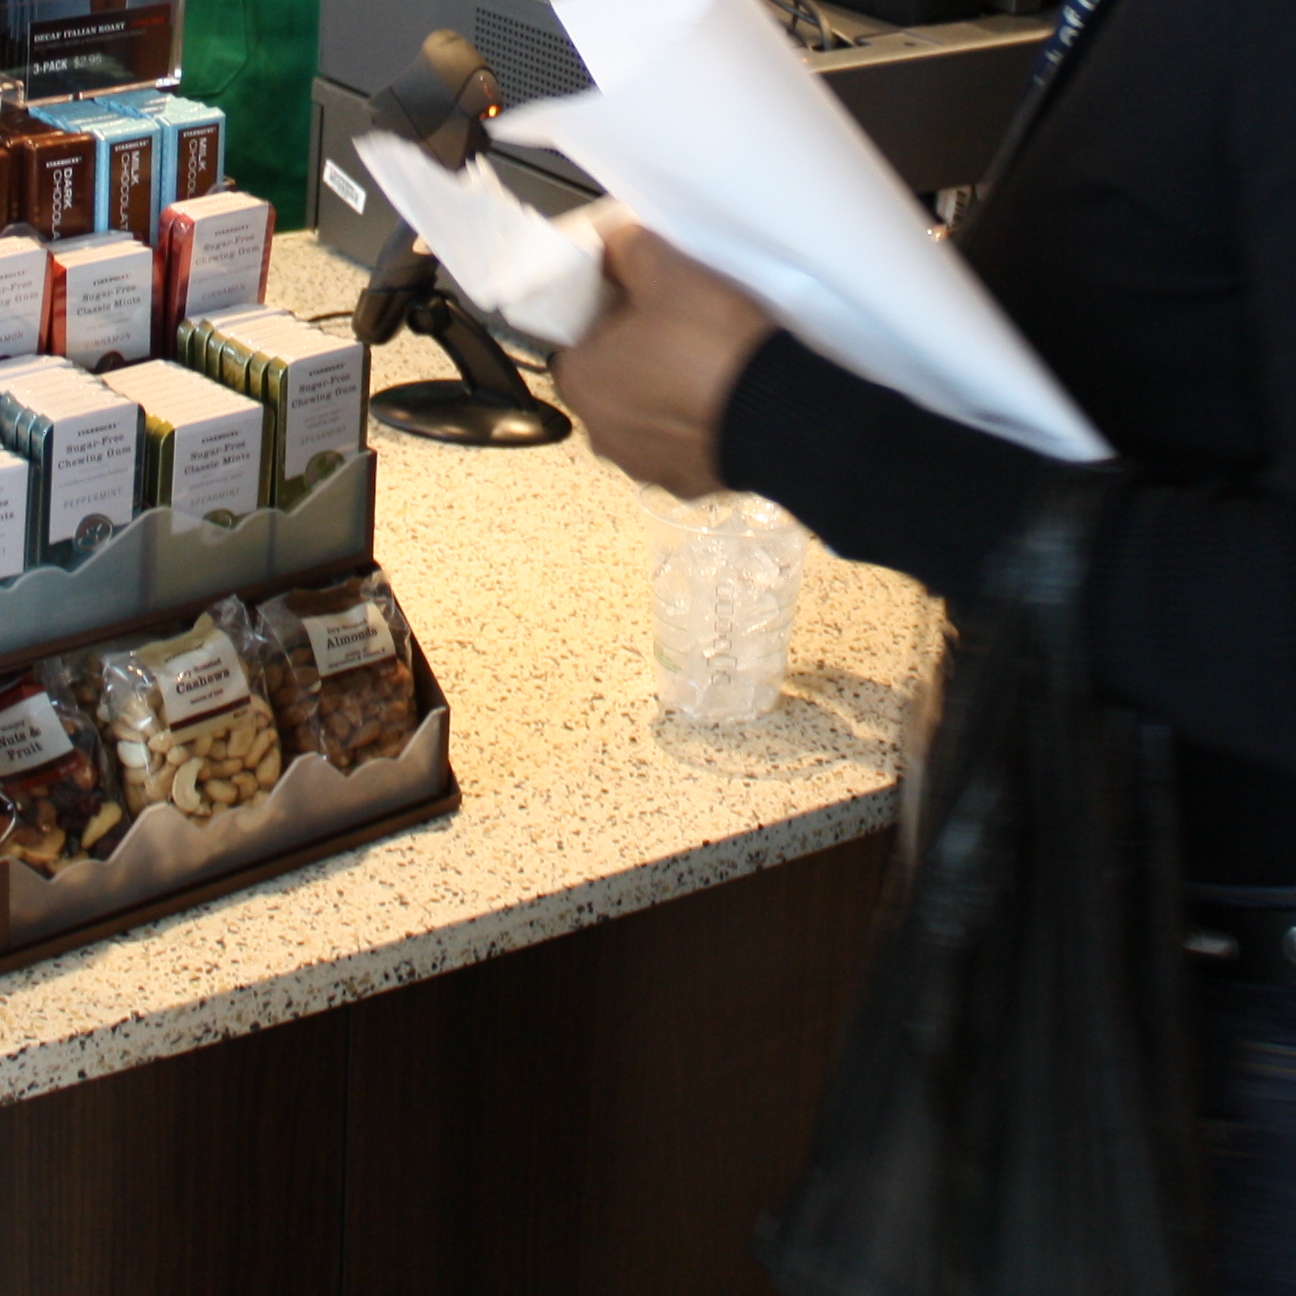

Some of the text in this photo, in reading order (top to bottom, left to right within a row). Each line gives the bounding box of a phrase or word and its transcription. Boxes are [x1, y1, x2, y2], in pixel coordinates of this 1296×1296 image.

[63, 25, 98, 39] ITALIAN
[99, 21, 126, 35] ROAST
[32, 58, 68, 75] 3-PACK
[198, 137, 208, 173] MILK
[130, 150, 140, 186] MILK
[63, 167, 73, 210] DARK
[325, 626, 379, 651] Almonds
[175, 668, 230, 696] Cashews
[28, 726, 42, 740] &
[6, 741, 44, 763] Fruit
